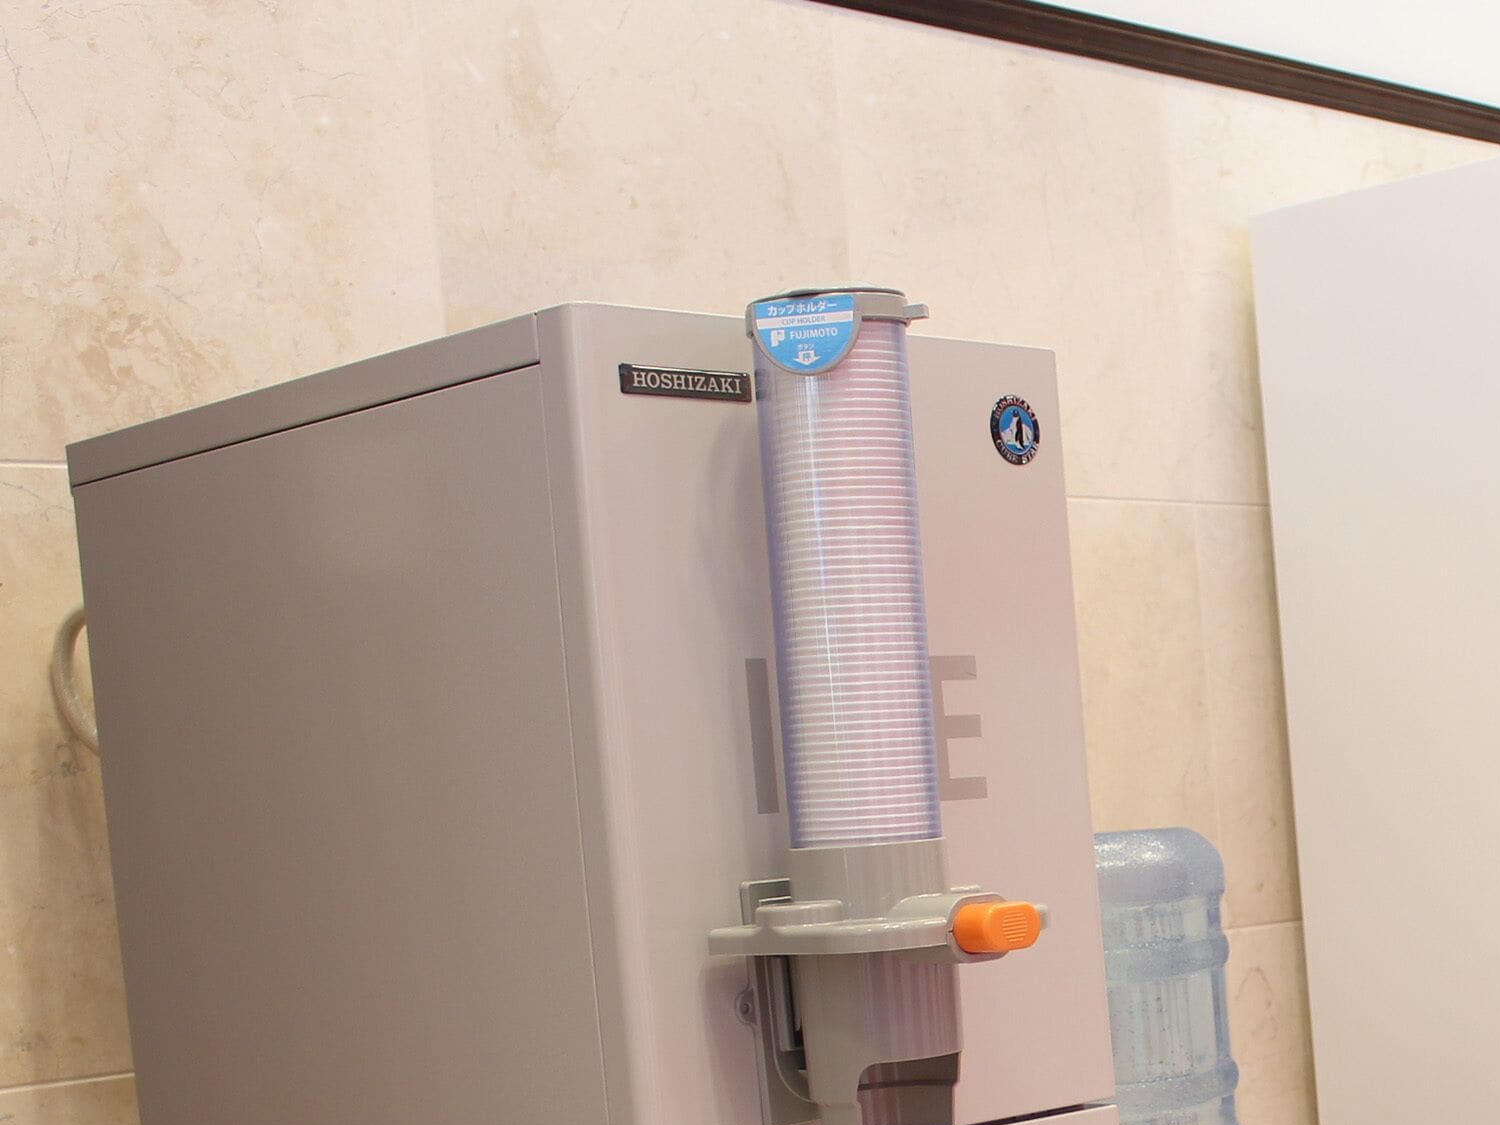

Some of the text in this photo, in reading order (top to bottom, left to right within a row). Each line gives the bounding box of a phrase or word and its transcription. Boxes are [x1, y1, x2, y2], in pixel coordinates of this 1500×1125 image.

[767, 301, 837, 316] カップホルダー
[790, 327, 838, 340] FUJIMOTO
[632, 371, 742, 394] HOSHIZAKI
